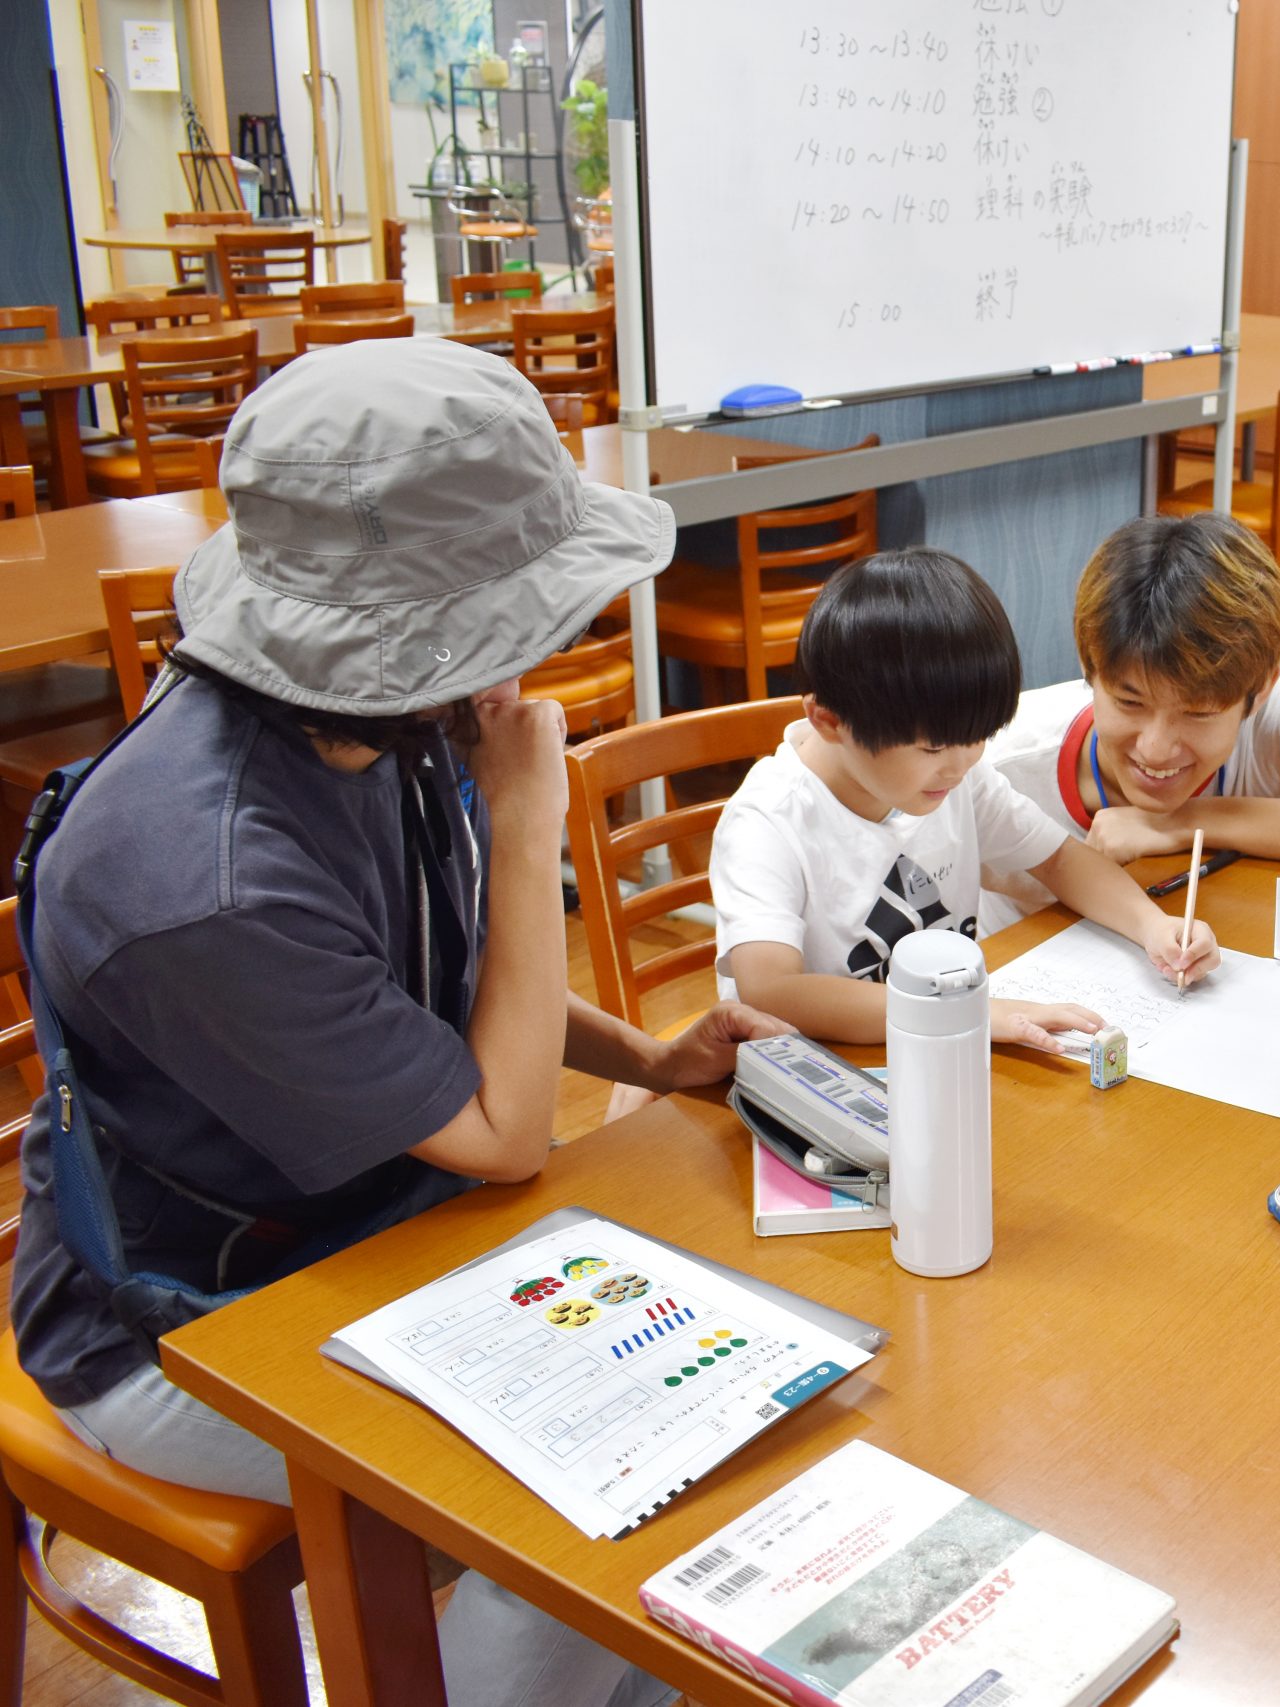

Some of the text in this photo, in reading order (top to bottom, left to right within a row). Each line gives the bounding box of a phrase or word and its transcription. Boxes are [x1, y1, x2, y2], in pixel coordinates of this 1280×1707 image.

[975, 40, 1040, 70] 休けい
[972, 83, 1020, 116] 勉強
[973, 132, 1029, 166] 休けい
[975, 279, 1018, 322] 終了
[896, 1569, 1014, 1670] BATTERY
